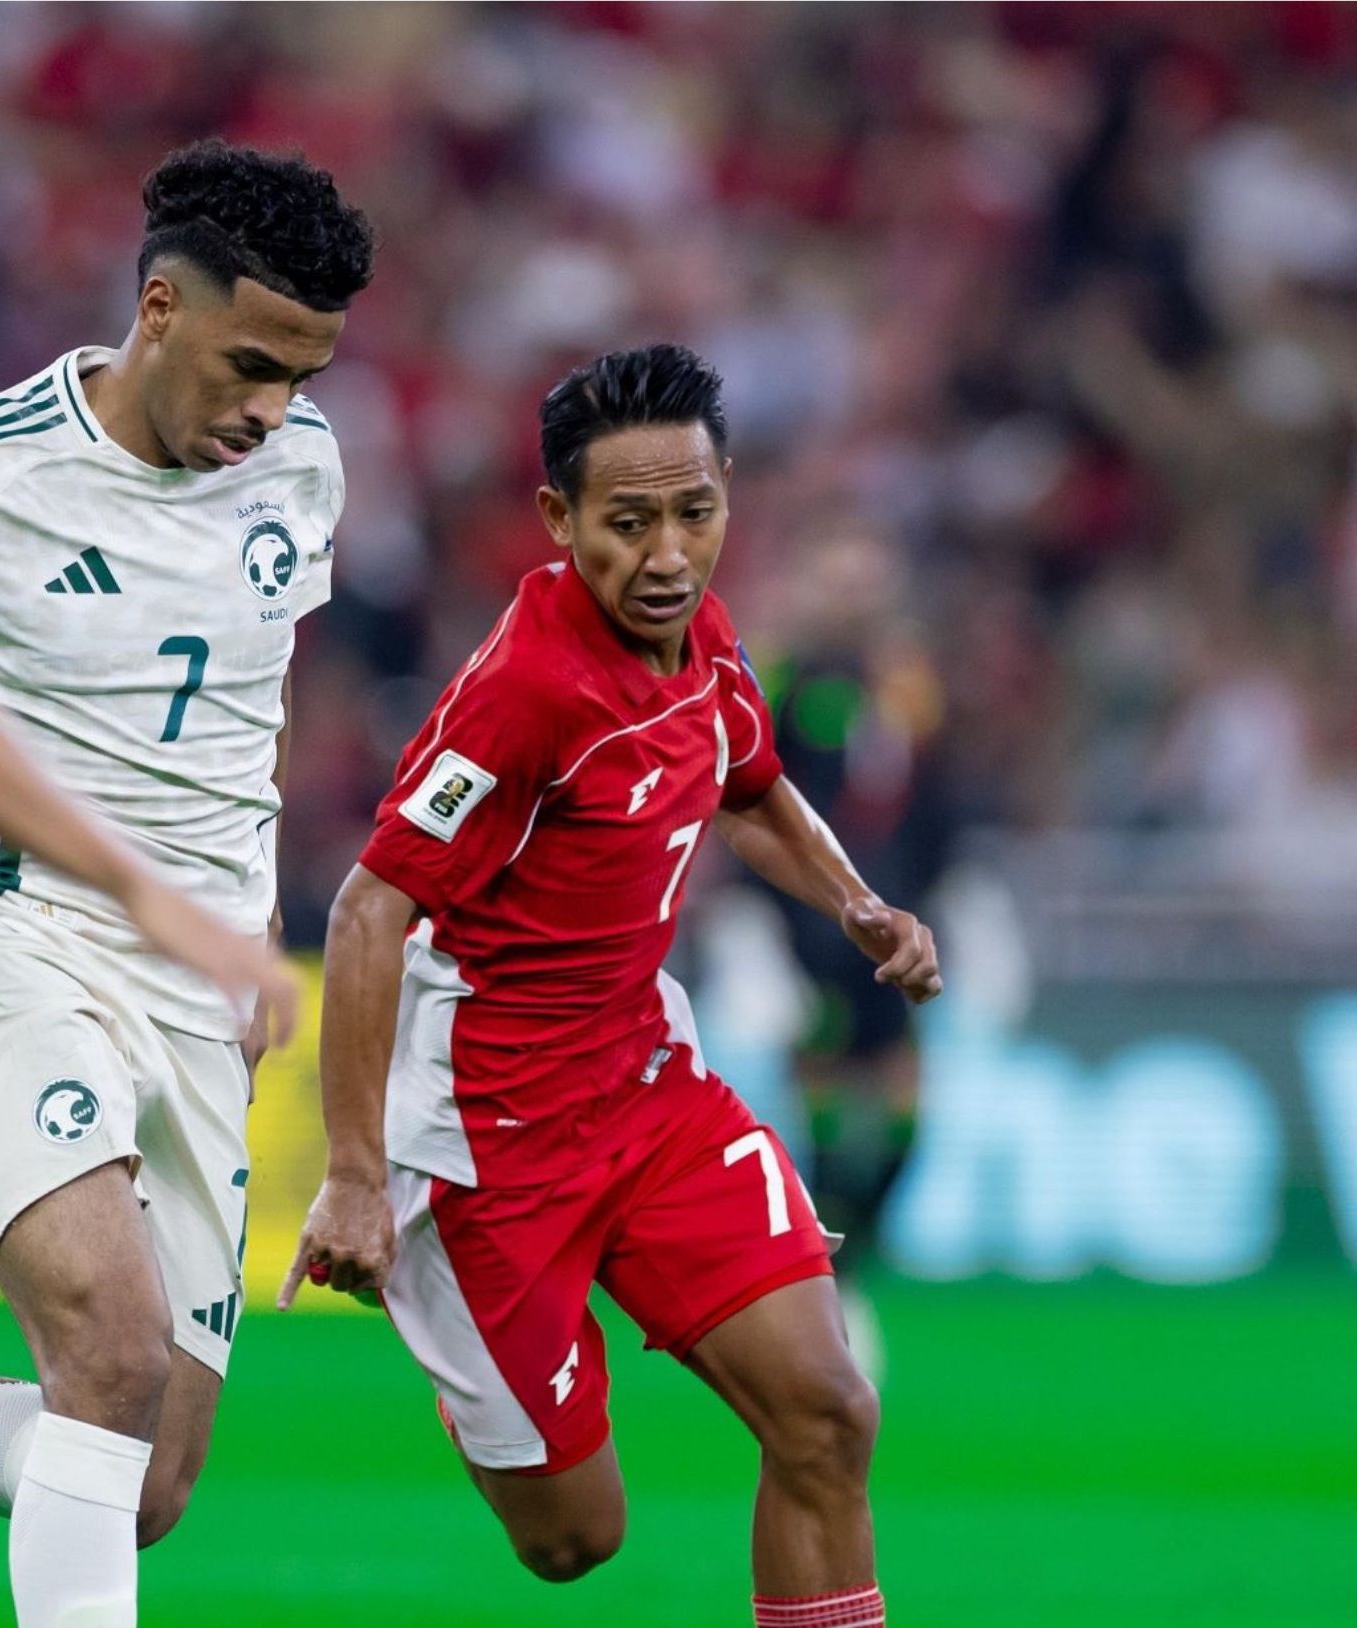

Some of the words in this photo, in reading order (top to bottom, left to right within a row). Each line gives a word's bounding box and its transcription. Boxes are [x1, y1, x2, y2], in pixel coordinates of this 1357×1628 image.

[158, 636, 209, 742] 7
[659, 819, 702, 923] 7
[724, 1129, 792, 1238] 7
